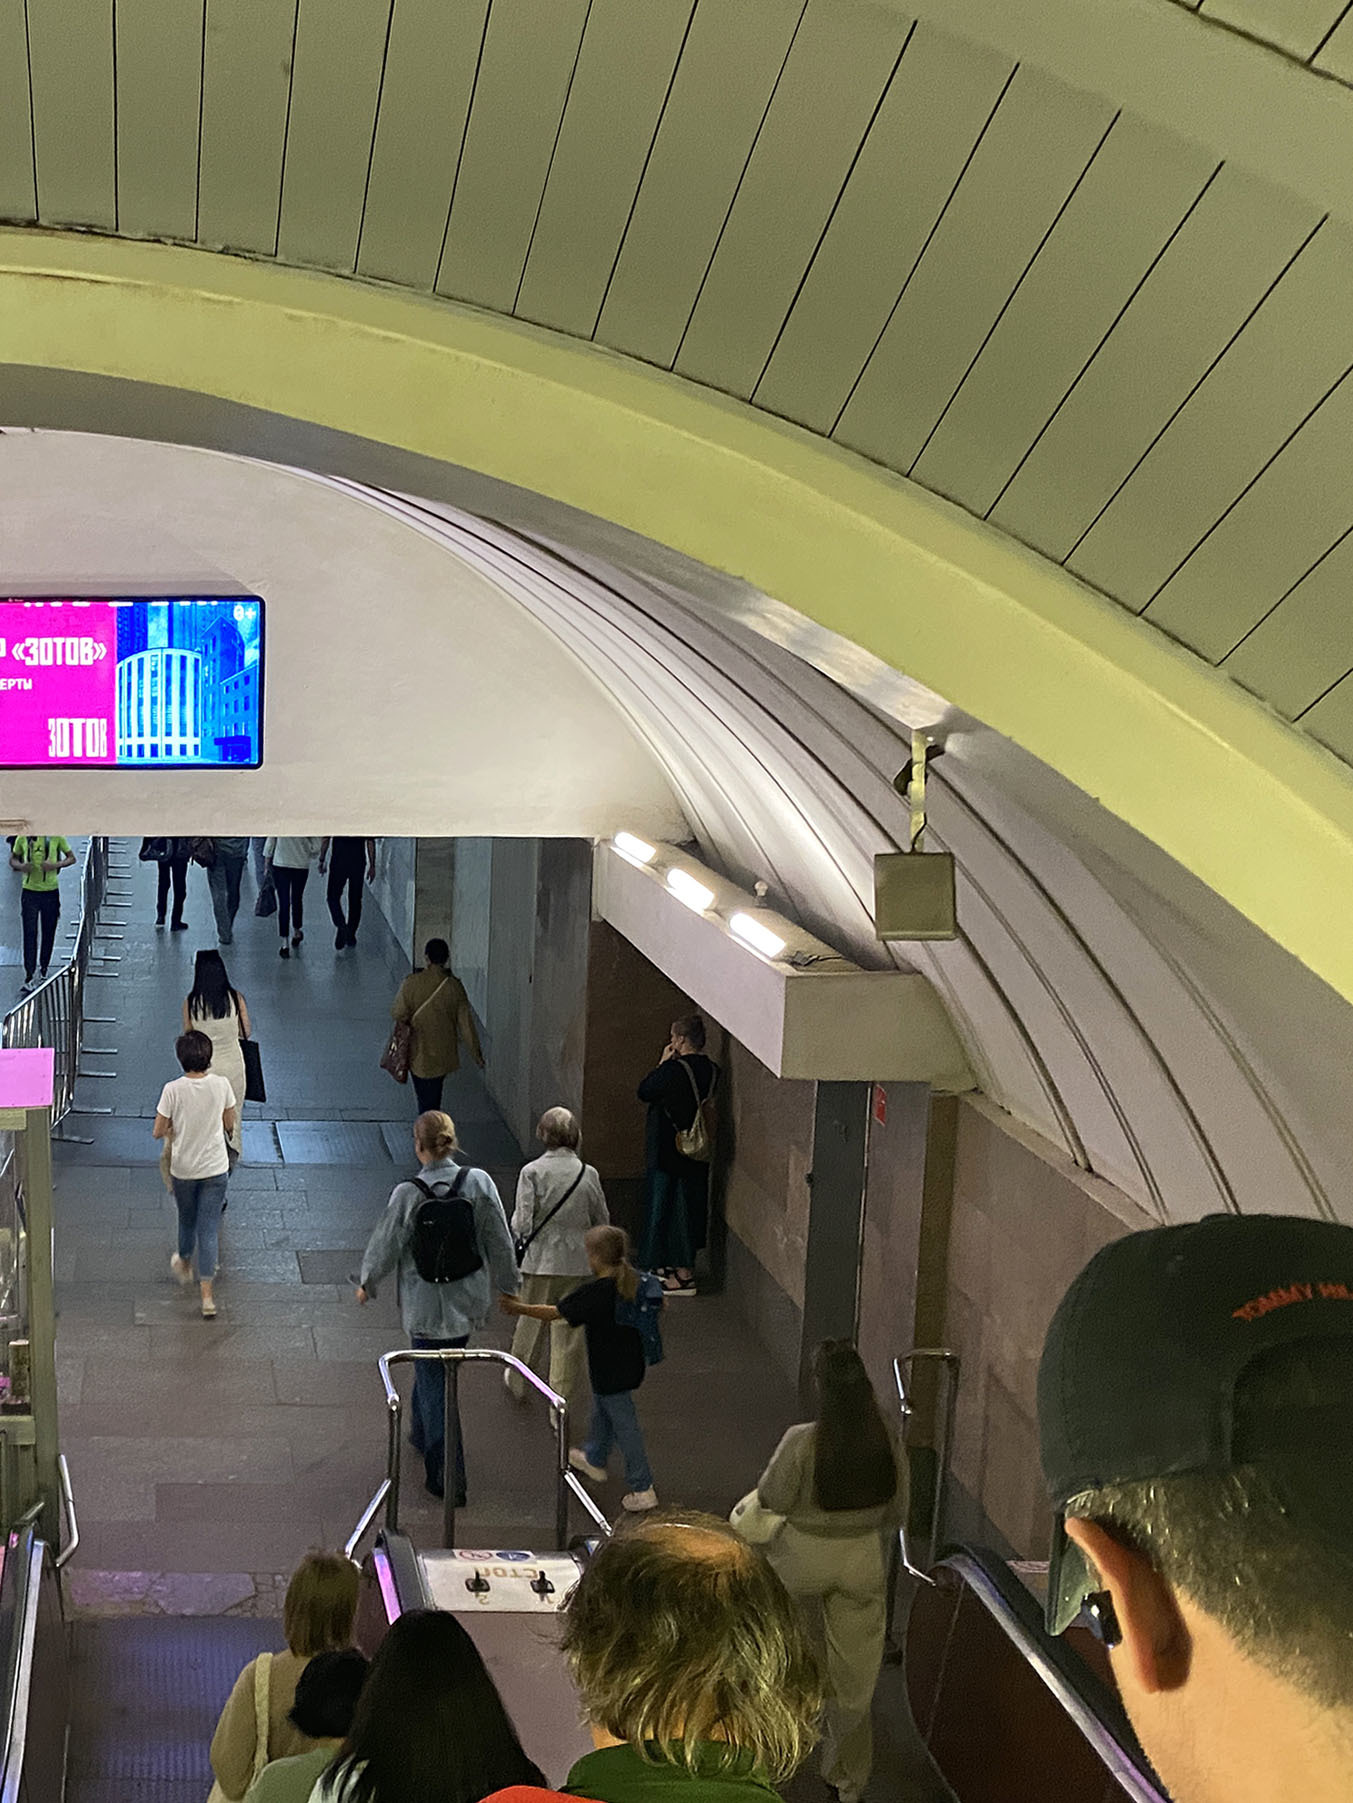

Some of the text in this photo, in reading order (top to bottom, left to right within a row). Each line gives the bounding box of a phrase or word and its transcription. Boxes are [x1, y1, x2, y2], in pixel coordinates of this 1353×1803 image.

[233, 604, 257, 621] 0+
[11, 637, 108, 666] «ЗОТОВ»
[48, 717, 107, 758] ЗОТОВ
[1232, 1284, 1313, 1322] TOMMY
